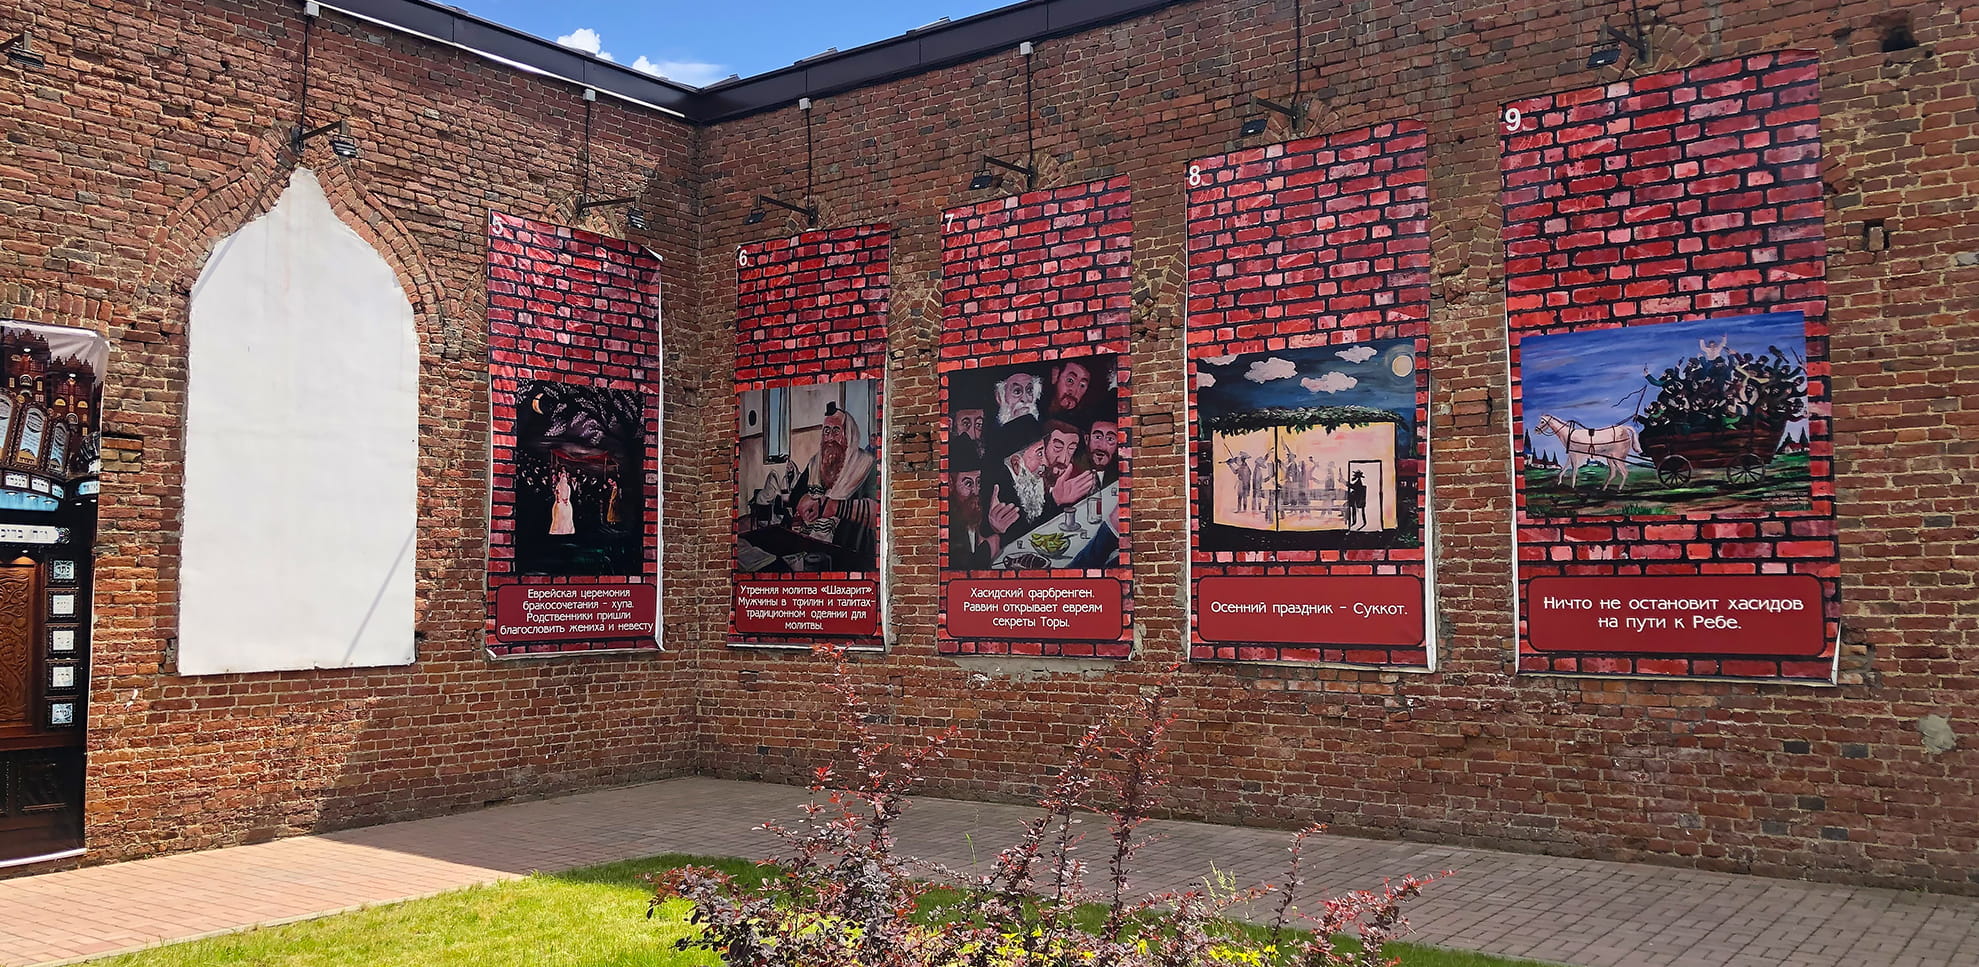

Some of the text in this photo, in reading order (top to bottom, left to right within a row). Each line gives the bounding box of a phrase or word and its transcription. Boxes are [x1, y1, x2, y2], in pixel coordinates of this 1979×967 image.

[1505, 107, 1520, 131] 9
[1189, 165, 1200, 186] 8
[492, 215, 503, 235] 5
[944, 213, 954, 232] 7
[739, 249, 748, 266] 6
[527, 589, 630, 601] Еврейская церемония
[740, 585, 779, 597] Утренняя
[971, 587, 1094, 601] Хасидский фарбренген.
[522, 599, 599, 611] бракосочетания
[611, 601, 634, 612] хупа.
[738, 597, 778, 608] Мужчины
[964, 602, 1102, 616] Раввин открывает евреям
[1544, 597, 1804, 612] Ничто не остановит хасидов
[526, 611, 631, 623] Родственники пришли
[745, 609, 866, 620] традиционном одеянии для
[1211, 602, 1266, 613] Осенний
[1273, 604, 1333, 617] праздник
[1354, 603, 1407, 618] Суккот.
[500, 625, 565, 635] благословить
[569, 624, 604, 632] жениха
[618, 622, 654, 633] невесту
[785, 622, 823, 630] молитвы.
[993, 616, 1070, 630] секреты Торы.
[1598, 616, 1741, 632] на пути к Ребе.
